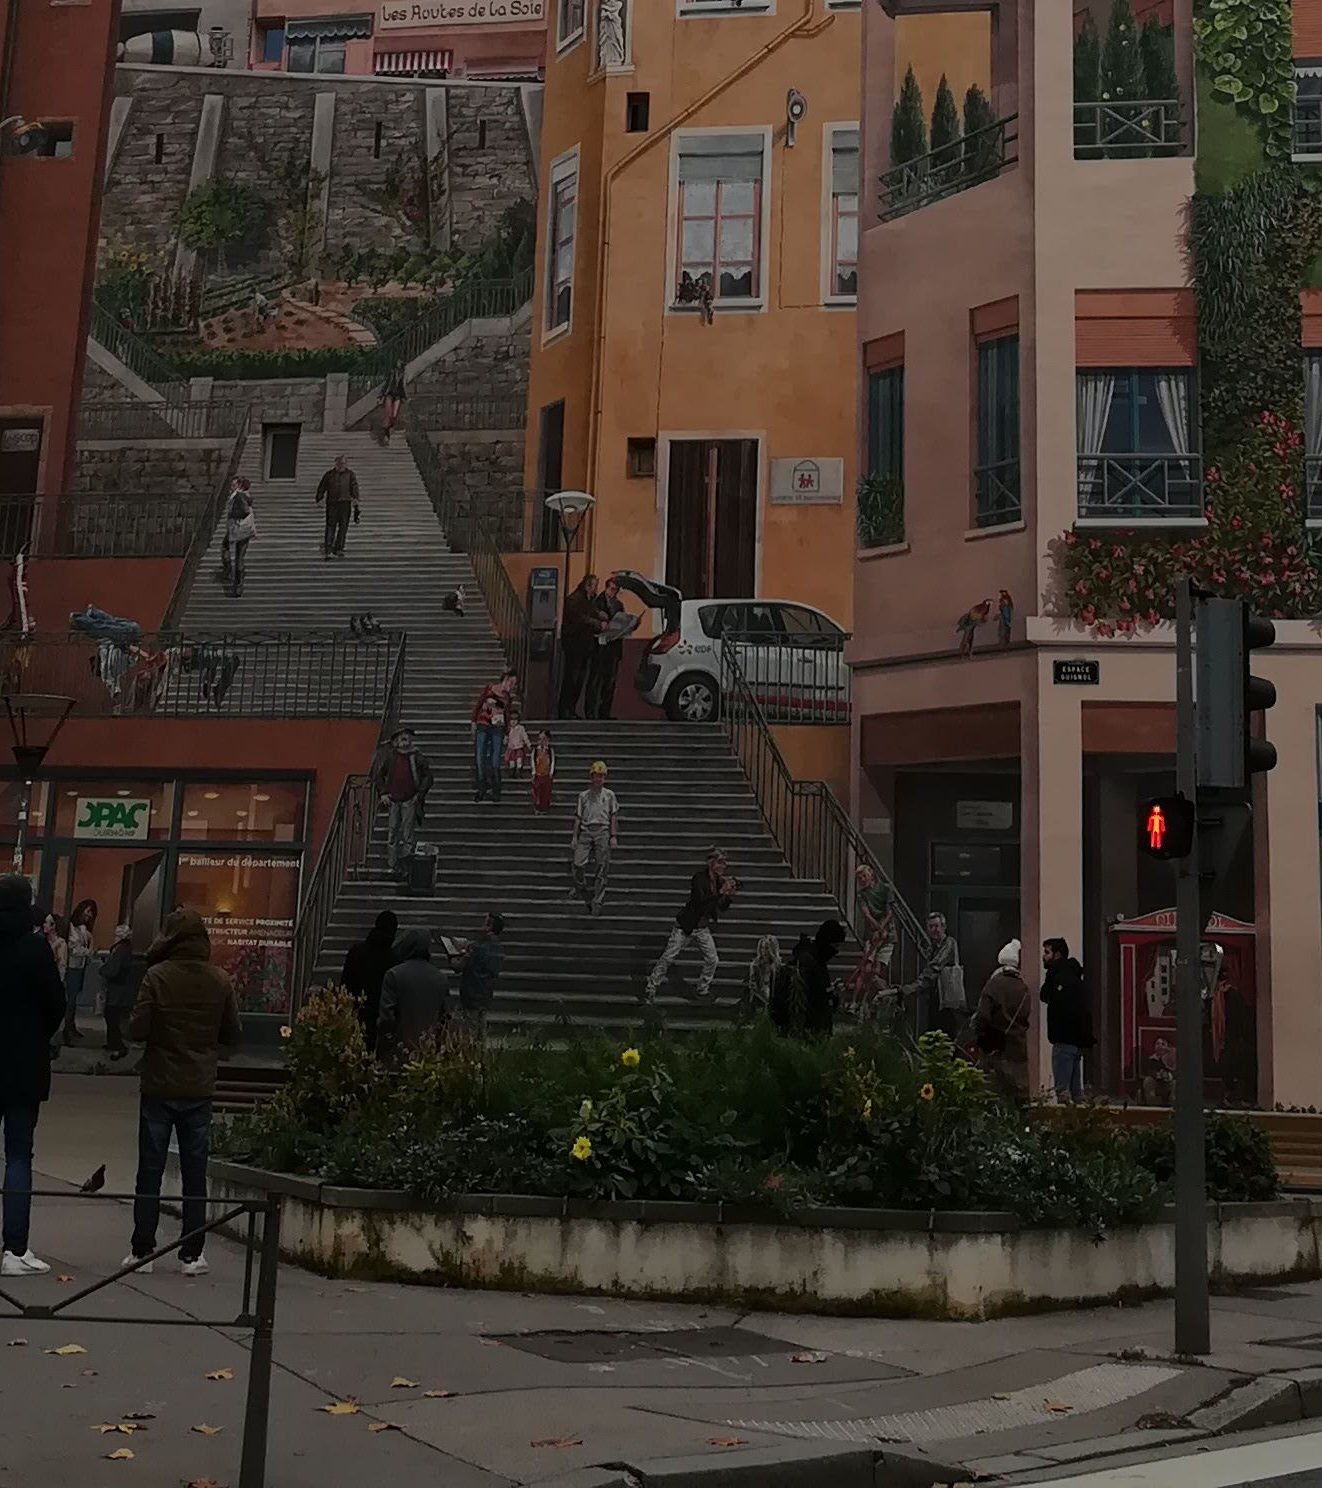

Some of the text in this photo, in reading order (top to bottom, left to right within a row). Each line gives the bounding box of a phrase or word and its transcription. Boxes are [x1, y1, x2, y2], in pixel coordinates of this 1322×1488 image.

[382, 5, 408, 21] Les
[468, 2, 486, 18] de
[1062, 665, 1090, 673] ESPACE
[1060, 673, 1092, 681] GUIGNOL
[190, 856, 226, 867] bailleur
[227, 856, 239, 867] du
[240, 855, 300, 868] département
[225, 917, 255, 926] SERVICE
[227, 938, 258, 947] HABITAT
[258, 939, 293, 948] DURABLE
